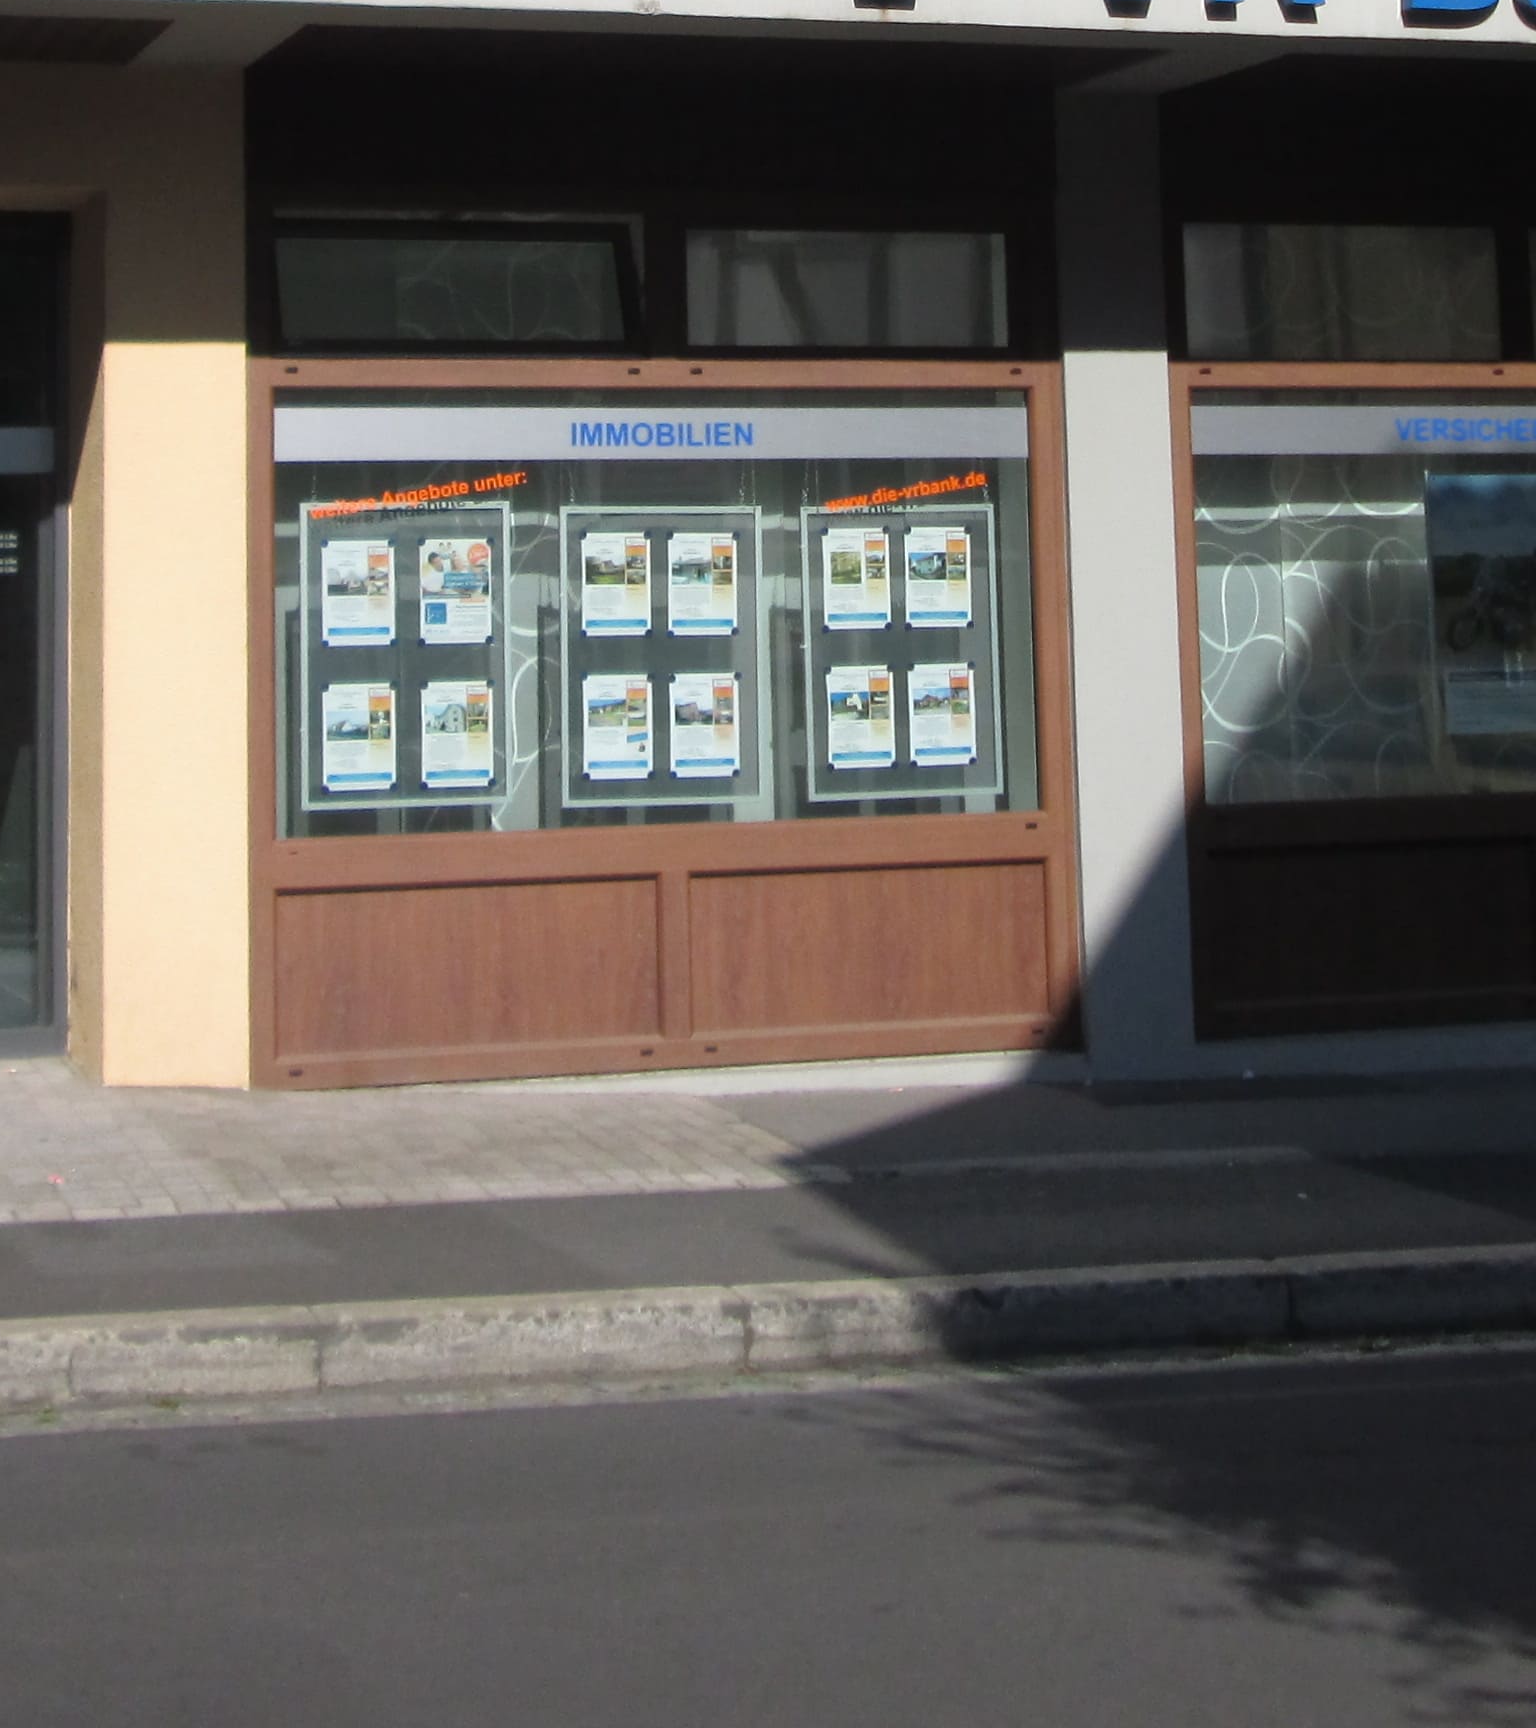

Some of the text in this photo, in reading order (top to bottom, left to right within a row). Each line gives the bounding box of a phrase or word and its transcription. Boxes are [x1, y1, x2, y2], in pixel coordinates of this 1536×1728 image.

[570, 421, 755, 449] IMMOBILIEN
[309, 471, 528, 519] weitere Angebote unter:
[824, 470, 988, 513] www.die-vrbank.de
